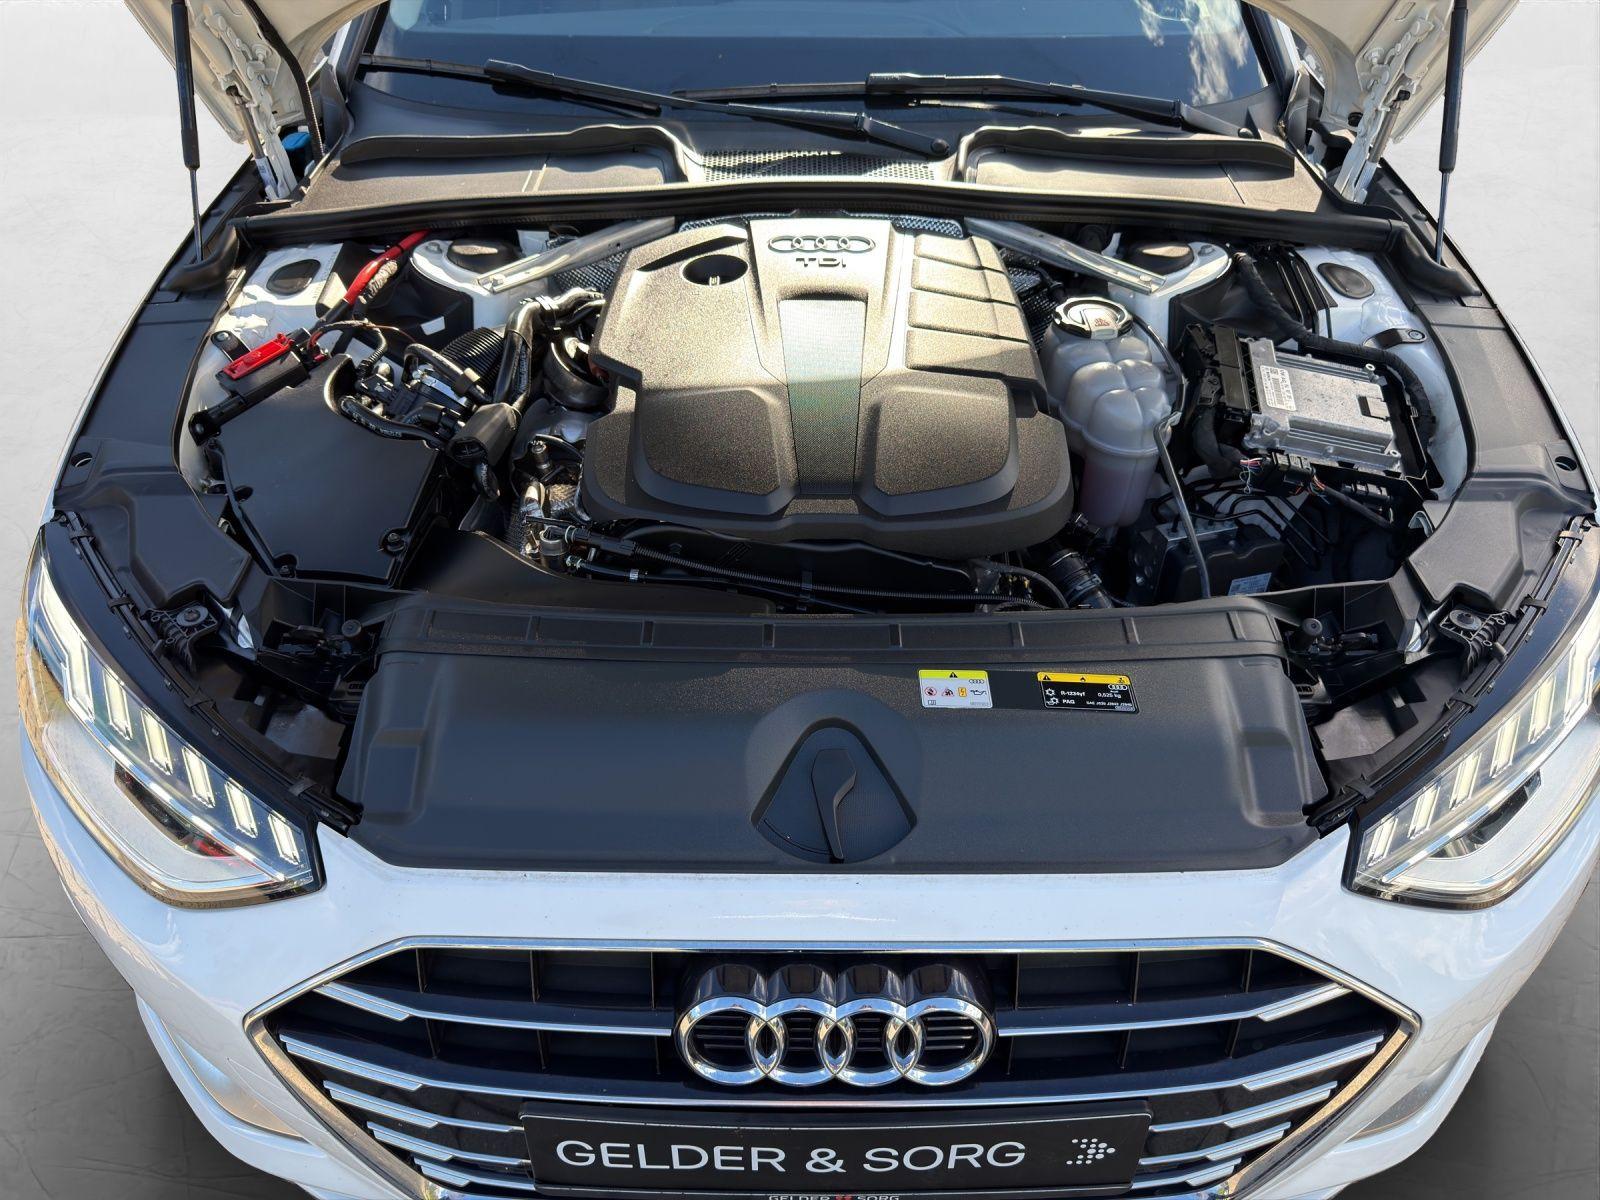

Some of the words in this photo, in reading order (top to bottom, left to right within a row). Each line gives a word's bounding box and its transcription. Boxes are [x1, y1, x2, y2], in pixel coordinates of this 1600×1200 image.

[795, 257, 847, 268] TDI
[557, 1141, 785, 1172] GELDER
[806, 1148, 846, 1173] &
[864, 1142, 1026, 1172] SORG
